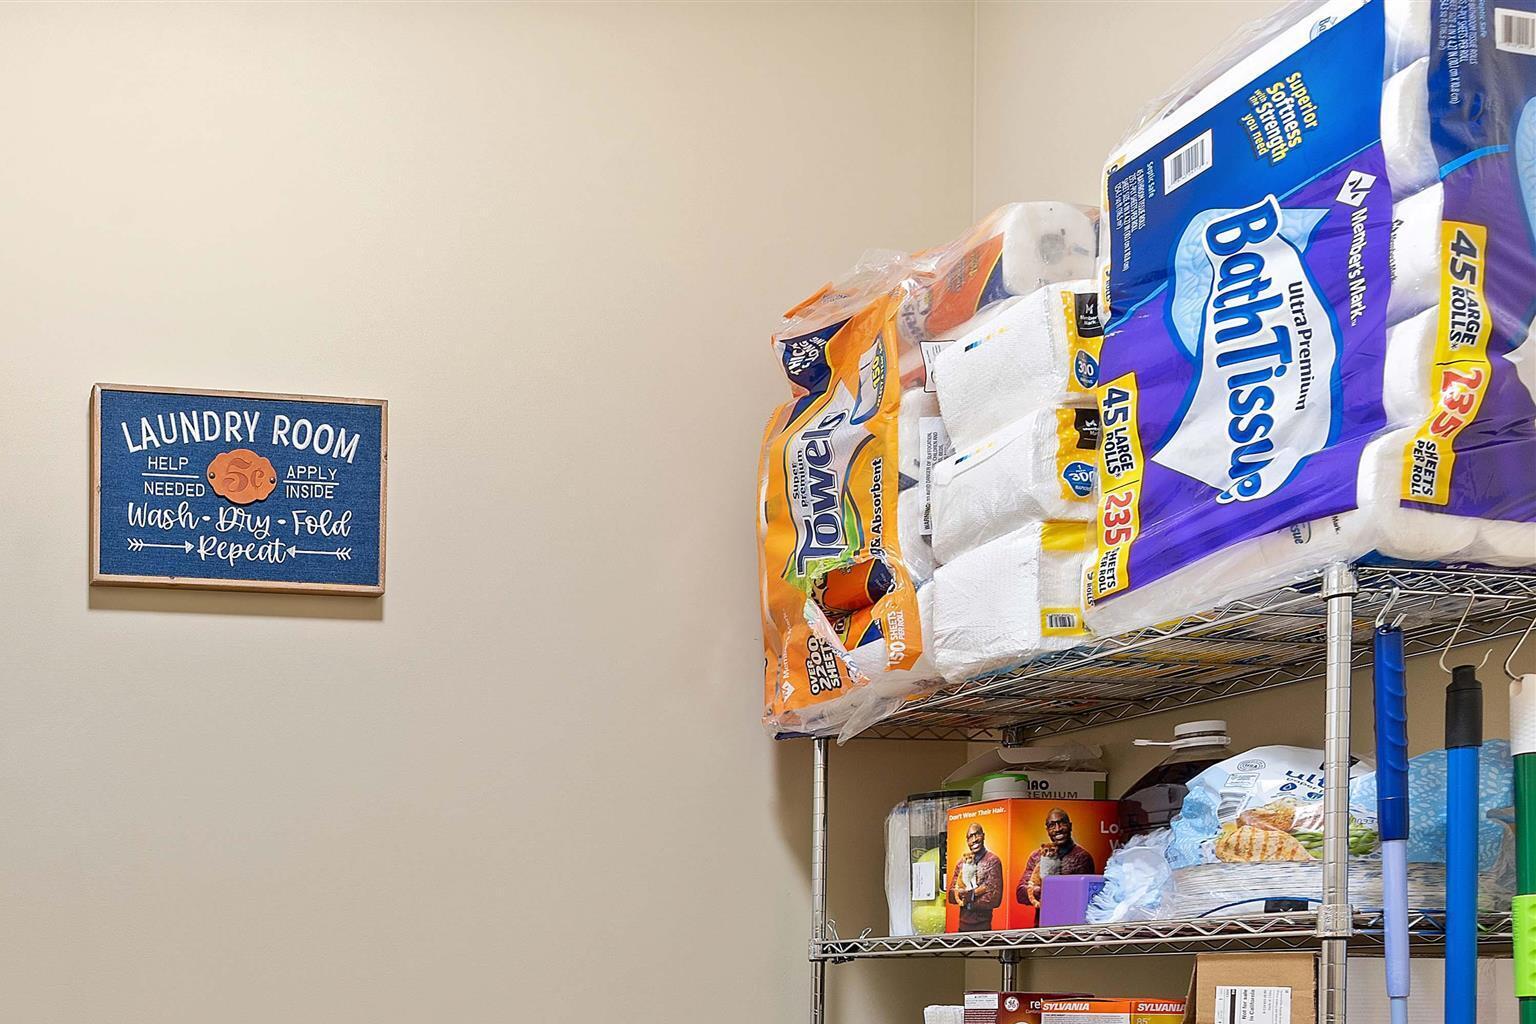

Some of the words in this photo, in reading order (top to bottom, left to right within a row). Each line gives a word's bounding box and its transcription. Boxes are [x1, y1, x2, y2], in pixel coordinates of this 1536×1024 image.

[1266, 82, 1302, 148] Softness
[1286, 71, 1318, 129] Superior
[1241, 113, 1256, 132] you
[1252, 132, 1268, 156] need
[1255, 101, 1290, 163] Strength
[1348, 207, 1368, 279] Member's
[1287, 281, 1308, 327] Ultra
[1449, 230, 1478, 285] 45
[1464, 288, 1481, 345] LARGE
[871, 355, 882, 390] 150
[1077, 362, 1094, 376] 300
[1295, 328, 1315, 411] Premium
[1102, 387, 1130, 427] 45
[1430, 369, 1483, 438] 235
[121, 410, 260, 453] LAUNDRY
[272, 414, 361, 463] ROOM
[1114, 427, 1134, 470] LARGE
[1413, 439, 1426, 463] PER
[148, 456, 189, 471] HELP
[287, 466, 338, 481] APPLY
[792, 462, 800, 500] Super
[797, 450, 809, 508] Premium
[1411, 464, 1423, 495] ROLL
[1421, 441, 1439, 497] SHEETS
[144, 481, 205, 497] NEEDED
[286, 485, 334, 499] INSIDE
[797, 411, 847, 576] Towels
[871, 458, 883, 534] Absorbent
[127, 501, 200, 530] Wash
[215, 506, 270, 539] Dry
[292, 510, 352, 537] Fold
[1104, 491, 1133, 546] 235
[197, 536, 287, 567] Repeat
[1098, 571, 1107, 593] ROLL
[888, 610, 898, 641] SHEETS
[807, 660, 820, 694] OVER
[808, 636, 833, 690] 2200
[949, 813, 962, 821] Don't
[962, 811, 977, 819] Wear
[992, 806, 1006, 814] Hair.
[1042, 1003, 1090, 1011] SYLVANIA
[1137, 1003, 1185, 1012] SYLVANIA
